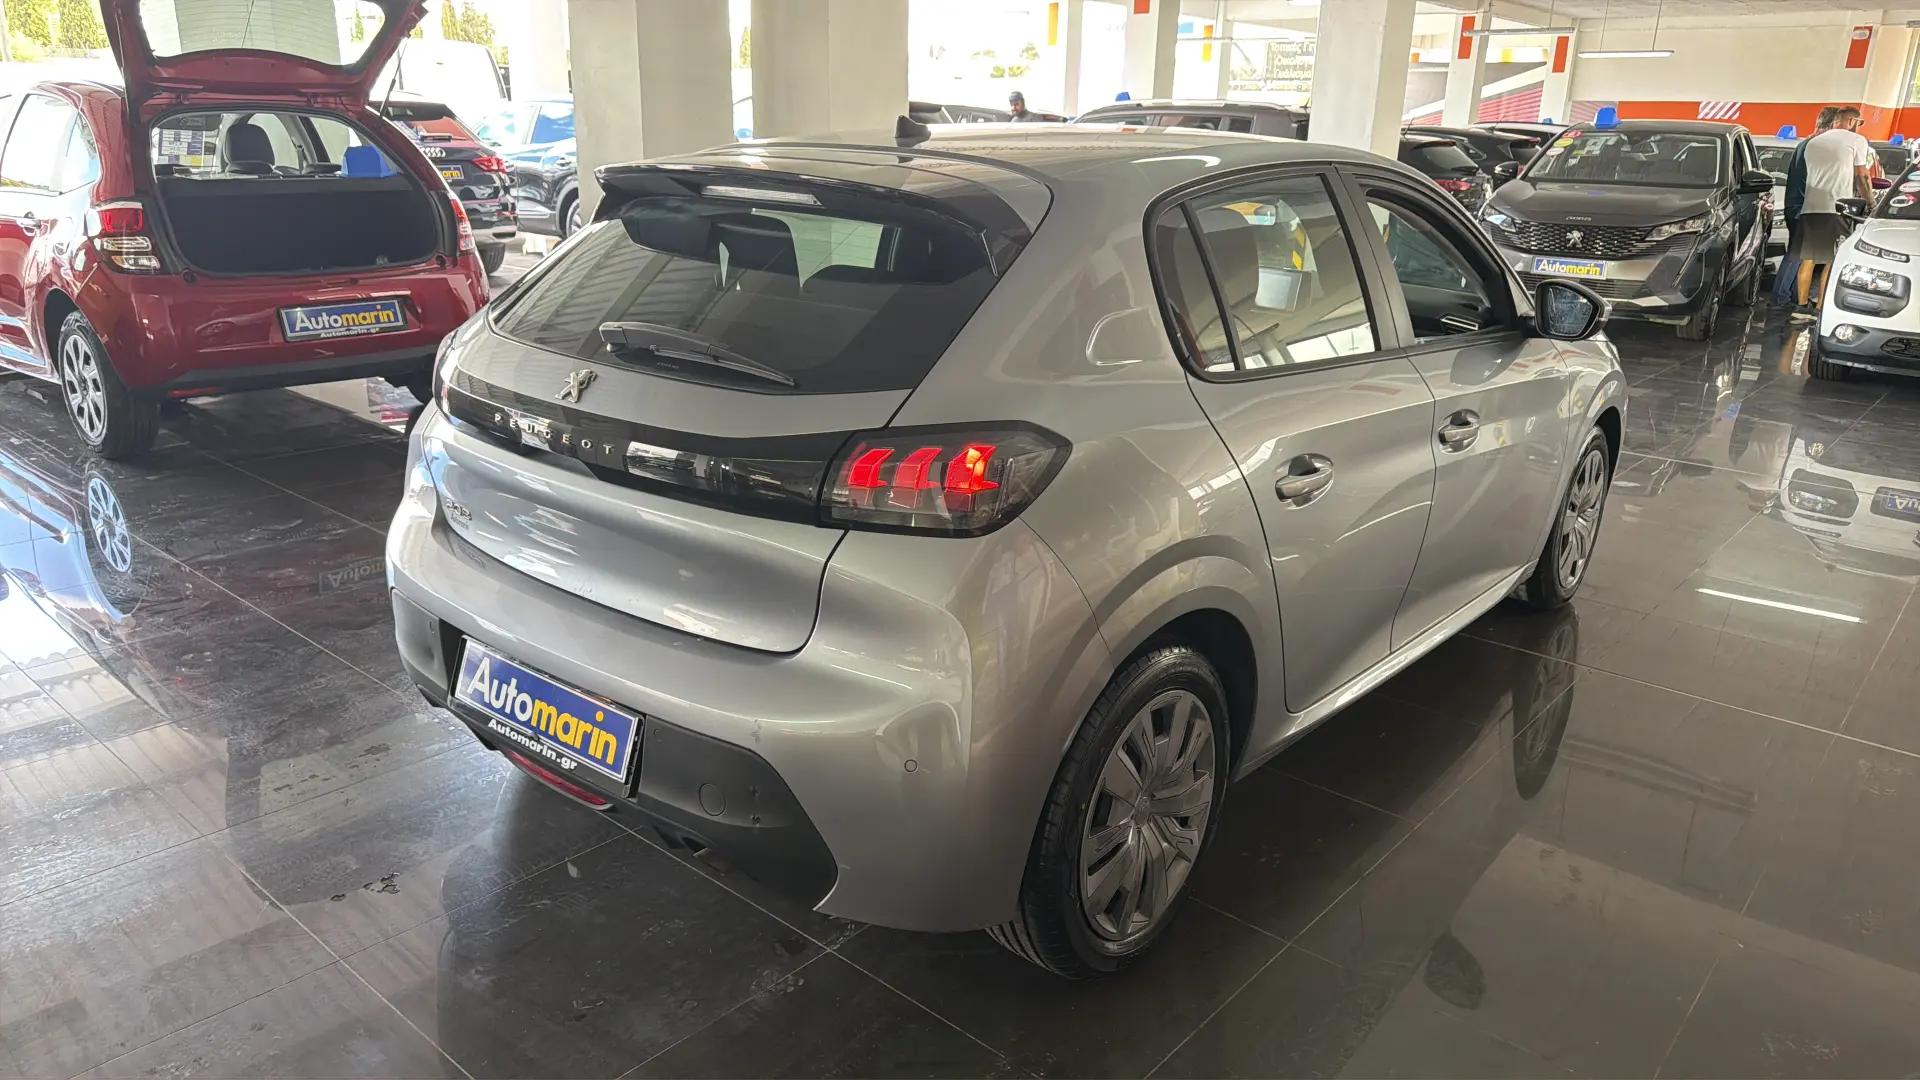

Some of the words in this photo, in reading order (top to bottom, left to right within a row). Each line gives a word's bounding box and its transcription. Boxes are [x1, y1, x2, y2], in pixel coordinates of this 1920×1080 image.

[1537, 259, 1600, 276] Automarin
[295, 305, 395, 331] Automarin
[320, 327, 380, 338] Automarin.gr
[494, 412, 614, 454] PEUGEOT
[467, 657, 618, 765] Automarin
[488, 718, 578, 771] Automarin.gr
